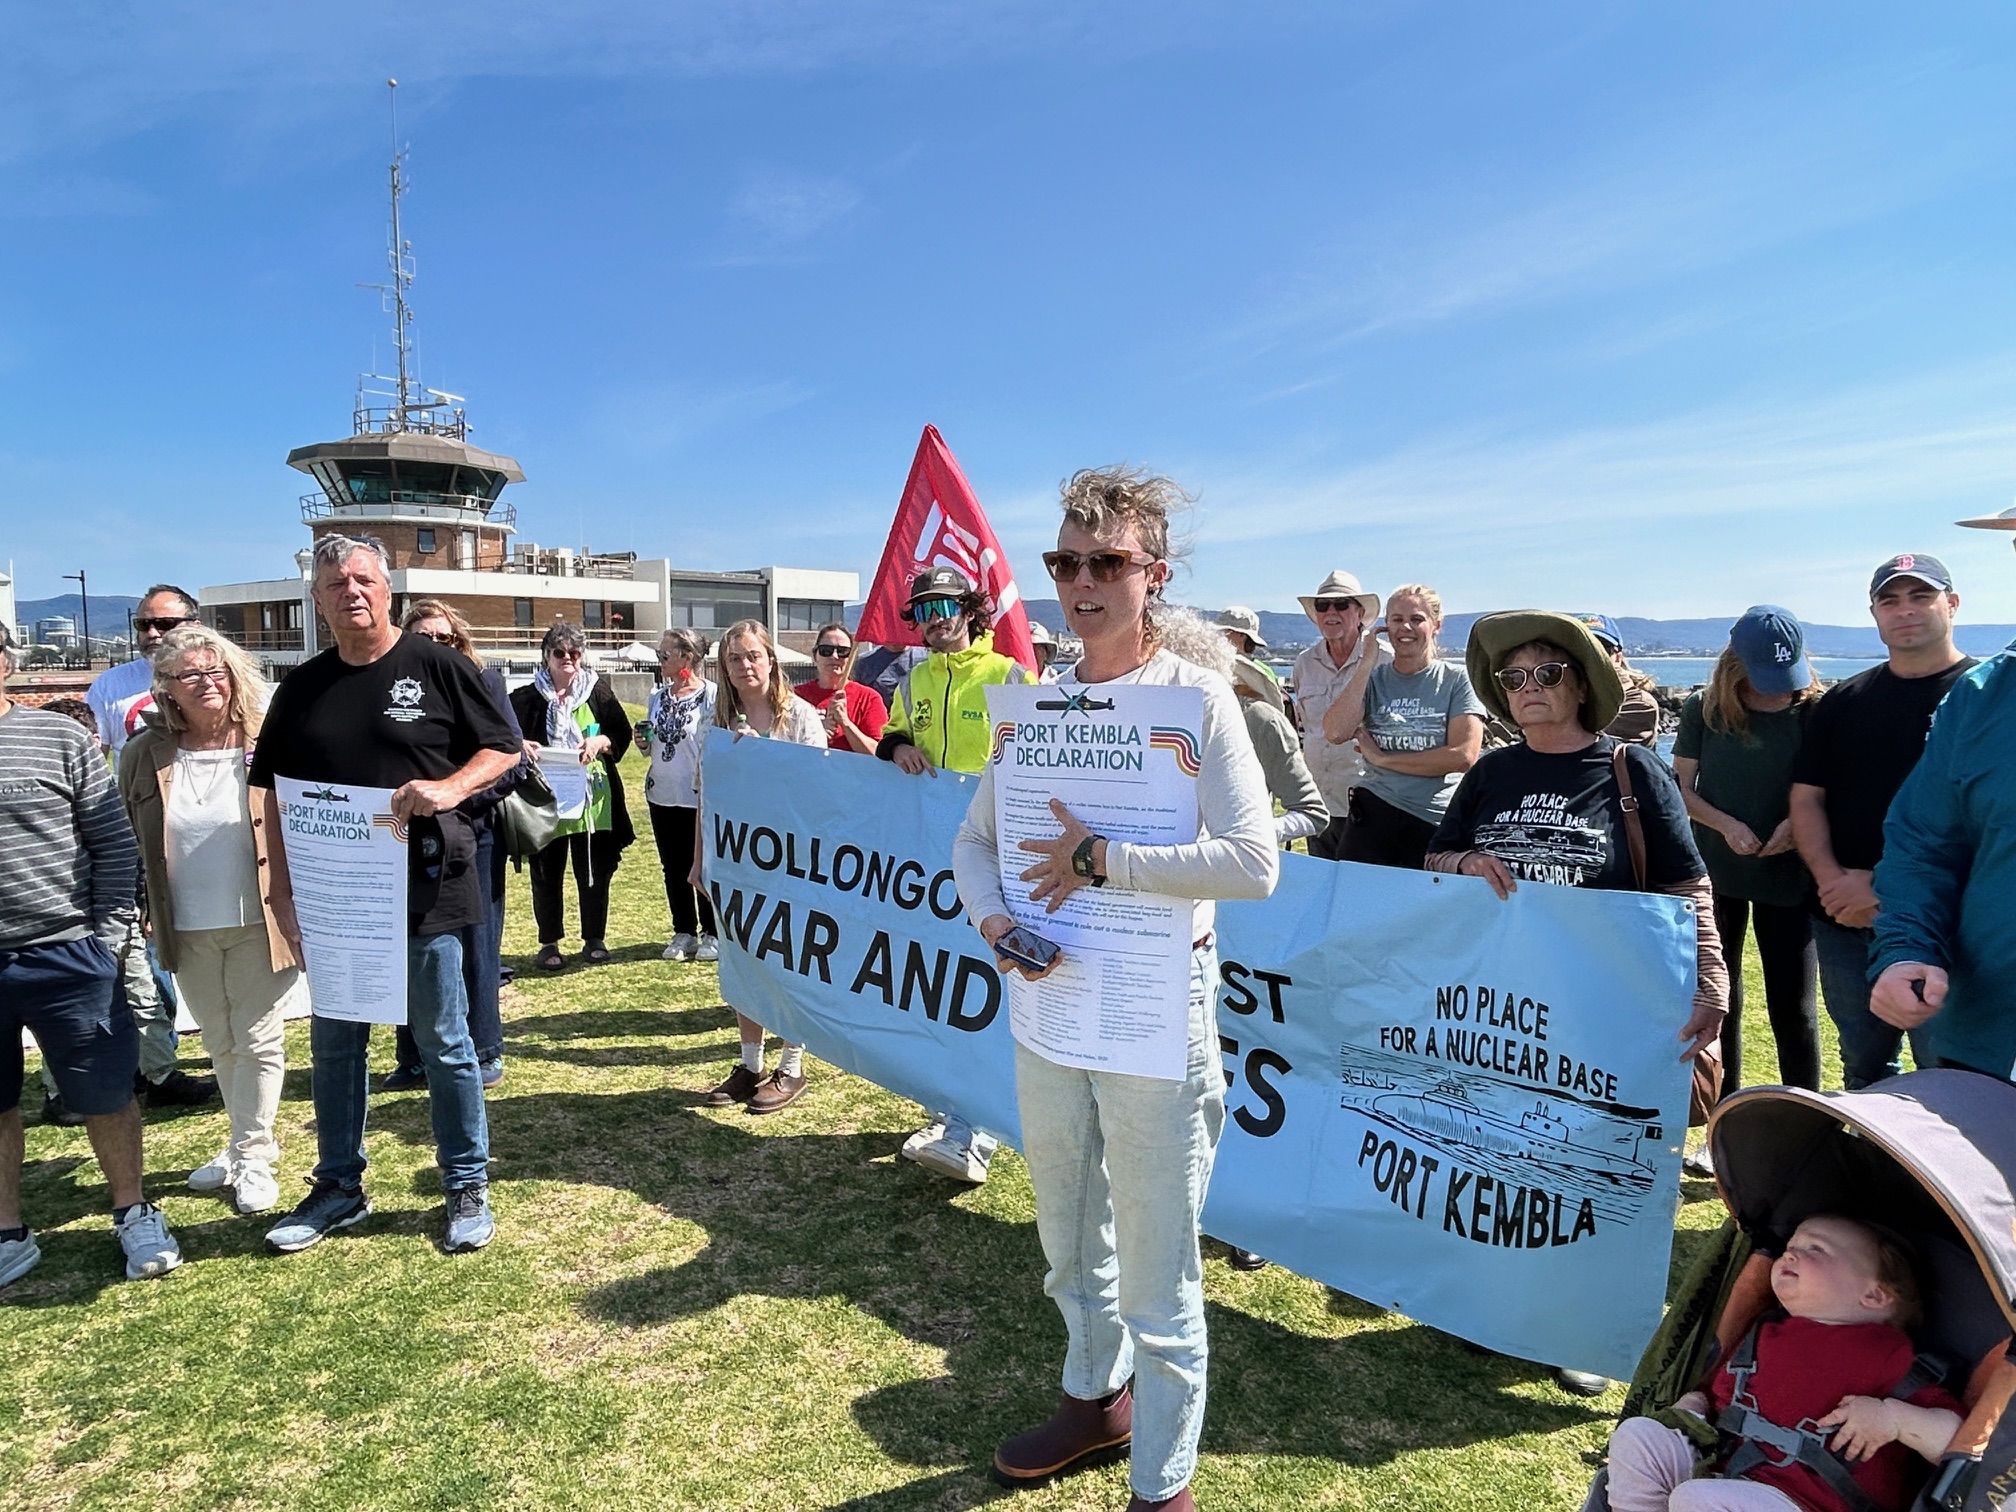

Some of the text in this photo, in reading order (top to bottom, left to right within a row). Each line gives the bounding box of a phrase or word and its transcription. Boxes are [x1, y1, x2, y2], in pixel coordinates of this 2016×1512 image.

[1894, 554, 1915, 571] B
[1774, 642, 1792, 662] LA
[1017, 723, 1142, 746] PORT KEMBLA
[1016, 747, 1142, 772] DECLARATION
[1520, 794, 1569, 810] NO PLACE
[288, 804, 368, 826] PORT KEMBLA
[1494, 809, 1589, 828] FOR A NUCLEAR BASE
[289, 819, 370, 840] DECLARATION
[714, 812, 964, 921] WOLLONGO
[1524, 862, 1584, 887] KEMBLA
[711, 880, 839, 984] WAR
[850, 930, 1001, 1033] AND
[1220, 960, 1292, 1024] ST
[1436, 984, 1550, 1041] NO PLACE
[1380, 1026, 1618, 1102] FOR A NUCLEAR BASE
[1358, 1130, 1596, 1248] PORT KEMBLA
